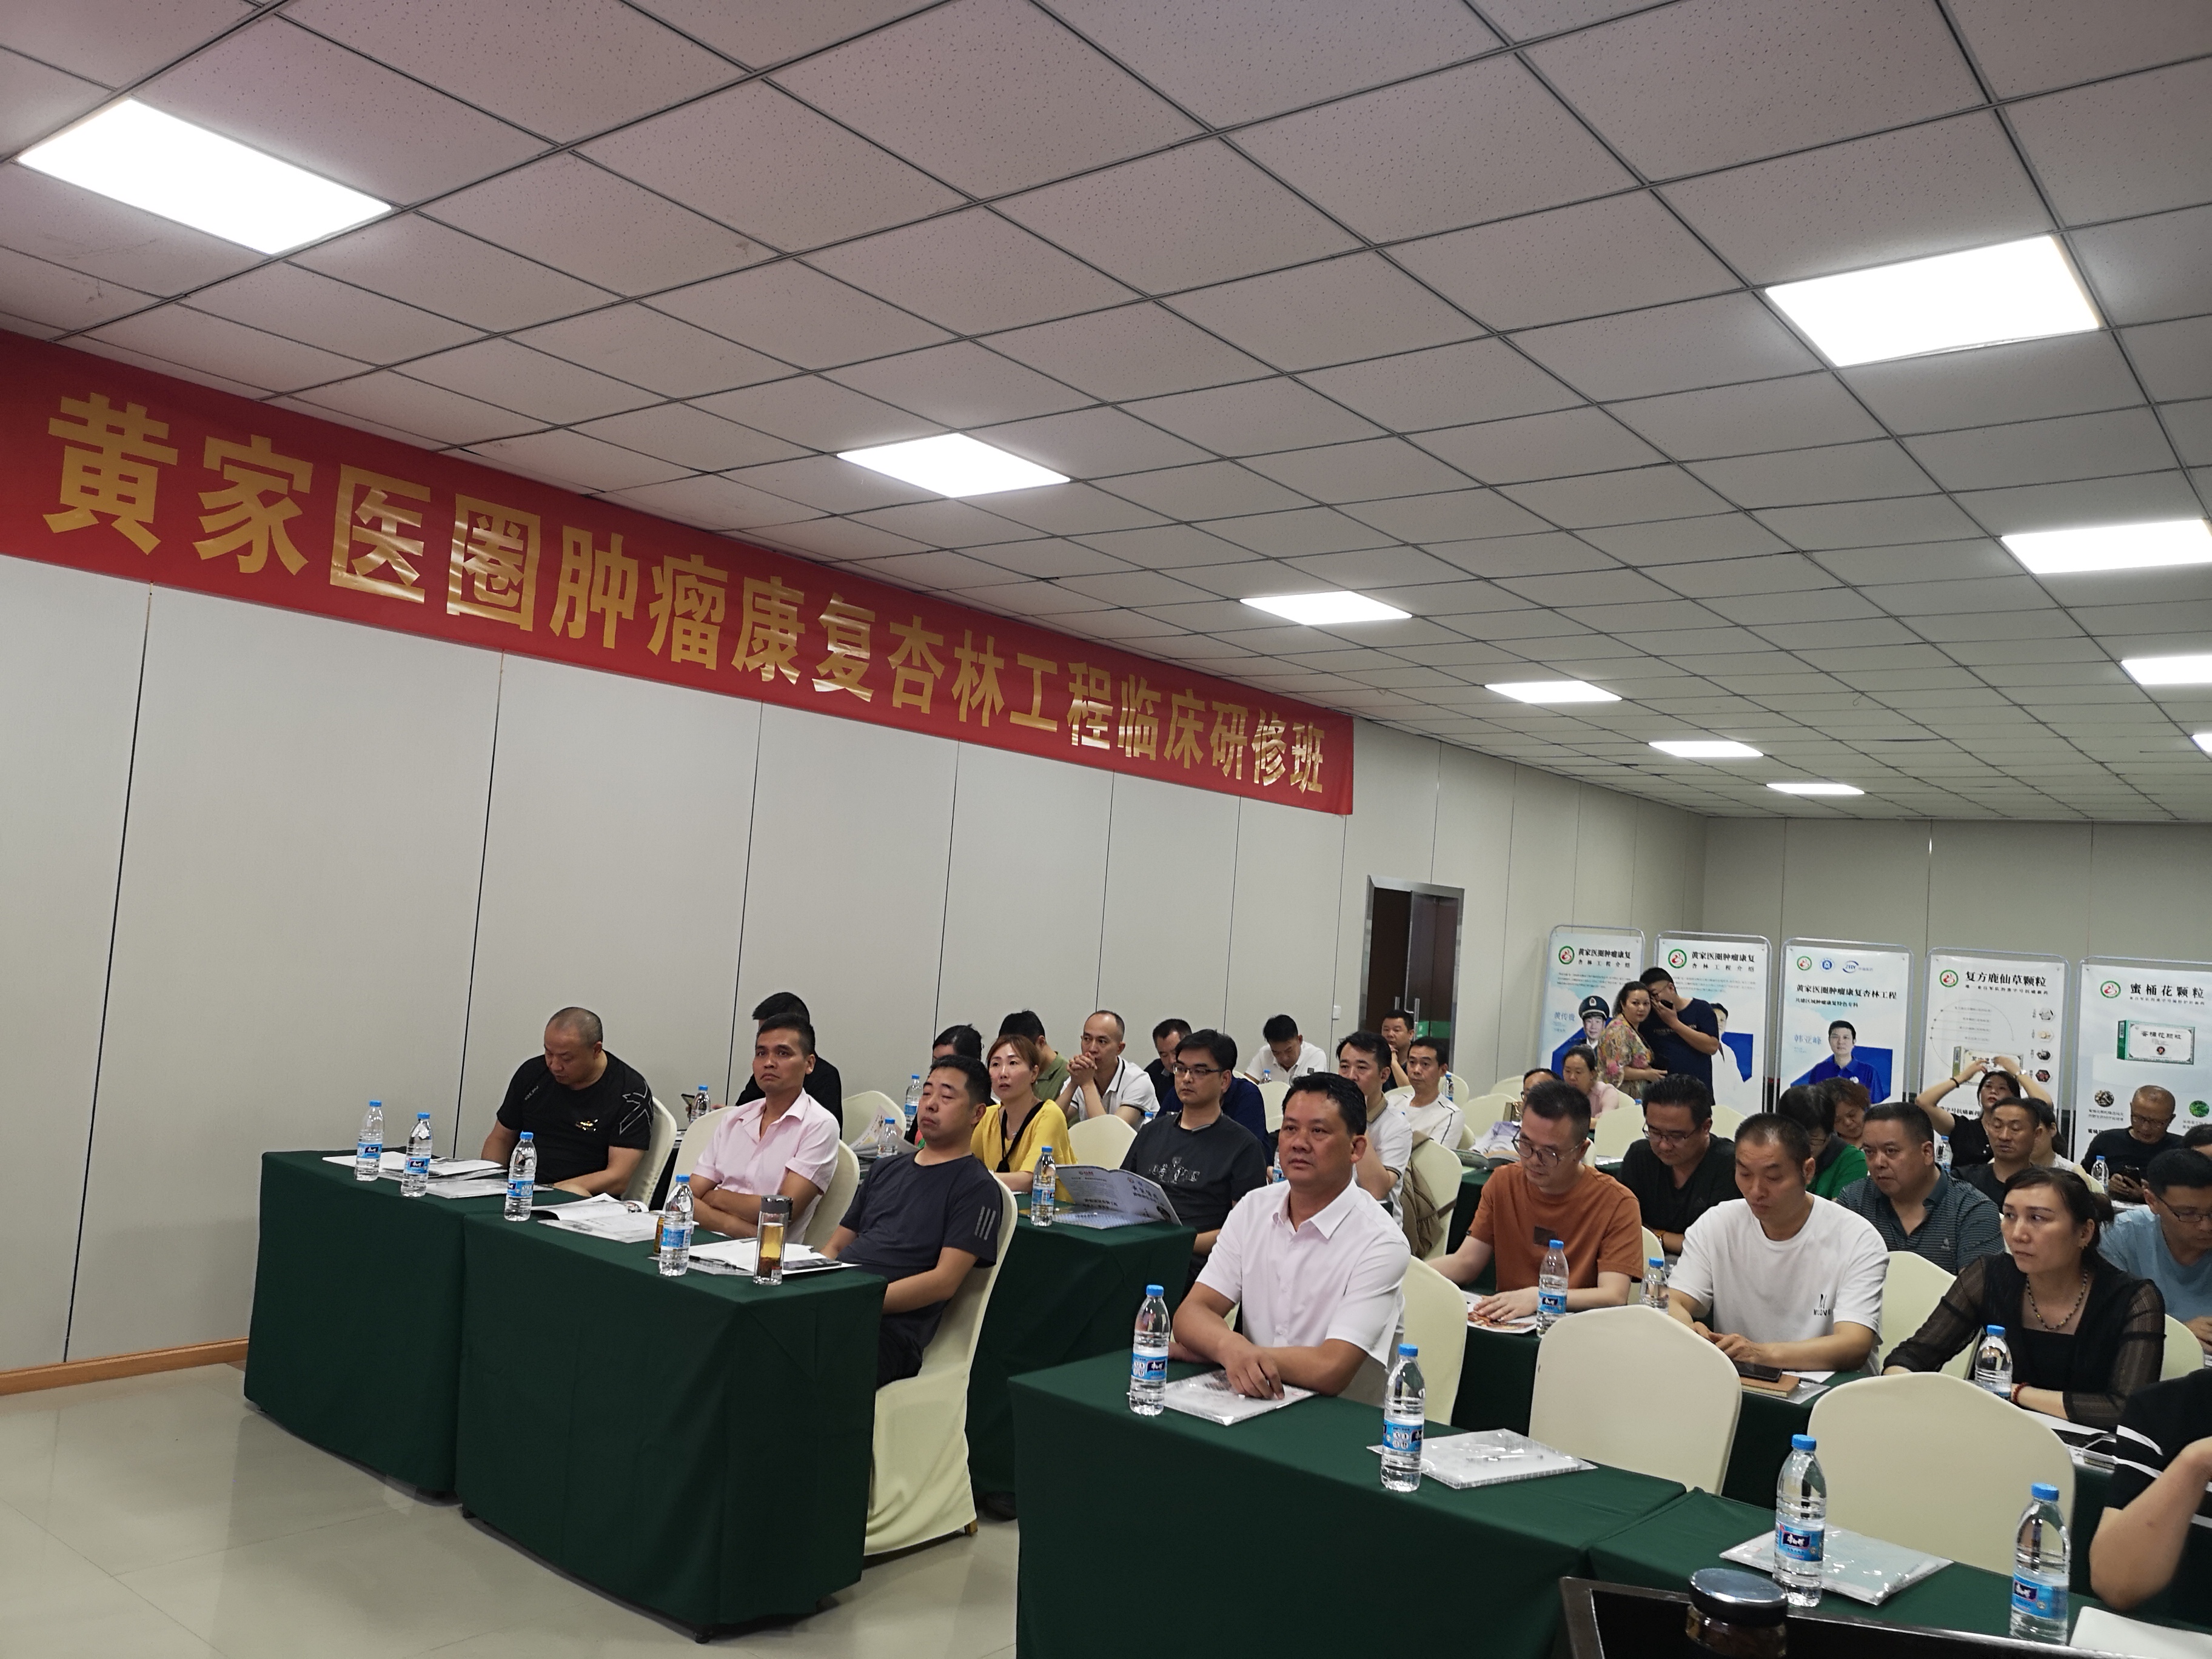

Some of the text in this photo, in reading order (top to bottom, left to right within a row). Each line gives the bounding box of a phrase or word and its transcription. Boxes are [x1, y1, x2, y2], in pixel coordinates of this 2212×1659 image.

[43, 392, 1326, 794] 黄家医圈肿瘤康复杏林工程临床研修班
[1578, 948, 1631, 959] 黄家医圈肿瘤康复
[1692, 951, 1755, 963] 黄家医圈肿瘤康复
[1578, 959, 1631, 968] 杏林工程介绍
[1692, 963, 1755, 972] 杏林工程介绍
[1965, 971, 2047, 987] 复方鹿仙草颗粒
[1797, 984, 1897, 1000] 黄家医圈肿瘤康复杏林工程
[2130, 982, 2205, 999] 蜜桶花颗粒
